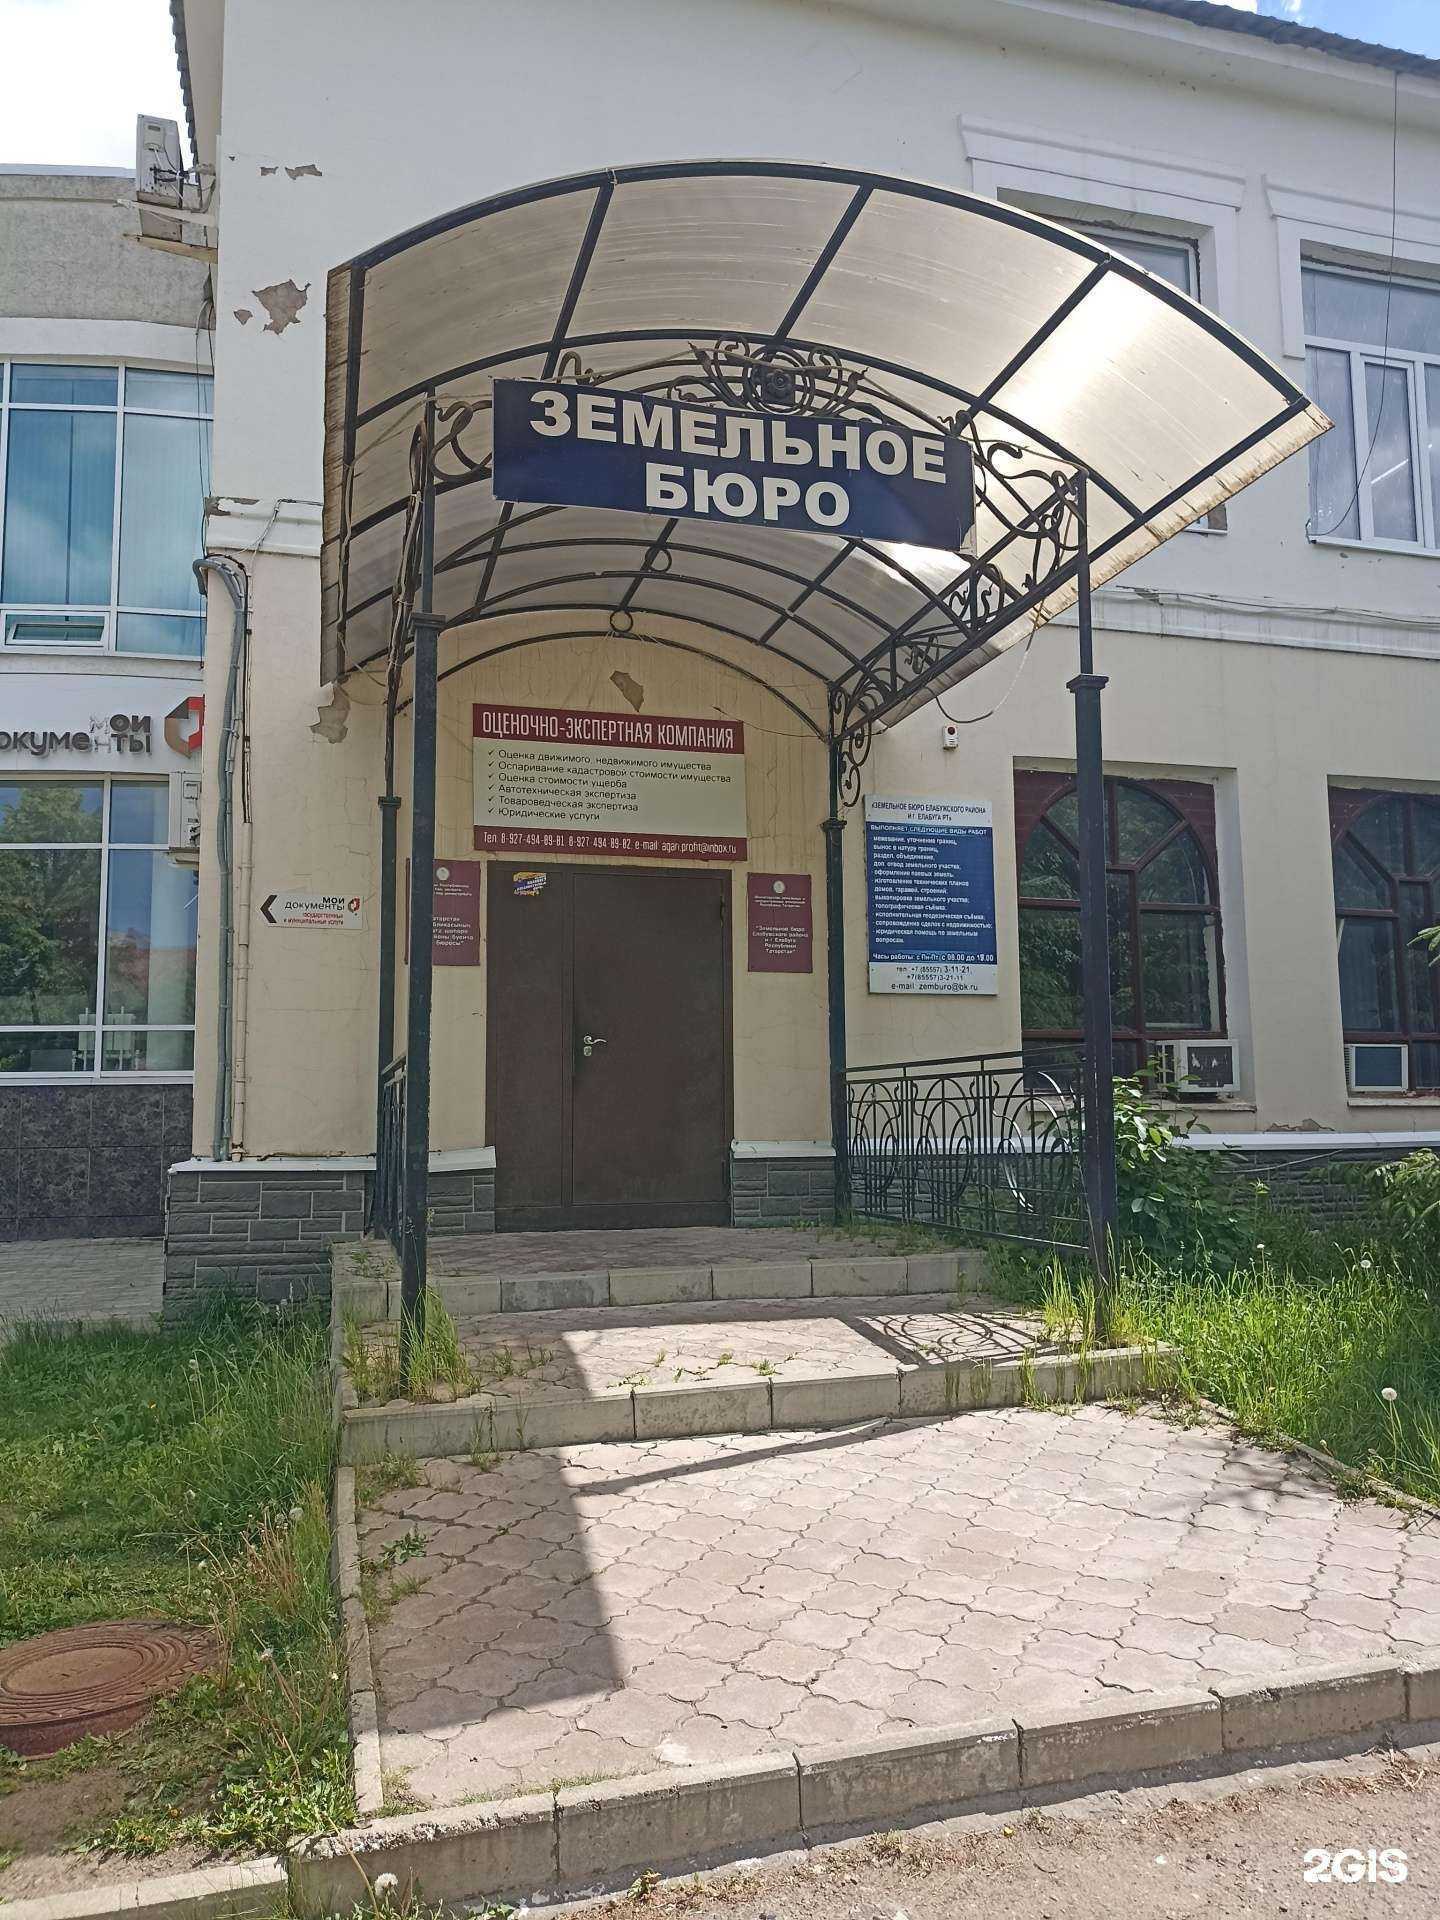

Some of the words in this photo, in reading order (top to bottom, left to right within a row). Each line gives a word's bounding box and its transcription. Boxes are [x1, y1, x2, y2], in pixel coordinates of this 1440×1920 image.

[530, 389, 948, 484] ЗЕМЕЛЬНОЕ
[645, 462, 850, 527] БЮРО
[482, 711, 652, 744] ОЦЕНОЧНО-ЭКСПЕРТНАЯ
[658, 724, 734, 749] КОМПАНИЯ
[498, 749, 535, 761] Оценка
[596, 757, 658, 768] недвижимого
[660, 761, 712, 772] имущества
[498, 761, 564, 773] Оспаривание
[567, 766, 627, 777] кадастровой
[629, 769, 678, 780] стоимости
[681, 773, 731, 783] имущества
[498, 772, 535, 784] Оценка
[538, 775, 589, 786] стоимости
[591, 779, 627, 789] ущерба
[498, 784, 582, 797] Автотехническая
[585, 789, 637, 801] экспертиза
[498, 795, 583, 808] Товароведческая
[586, 801, 639, 812] экспертиза
[498, 807, 566, 819] Юридические
[569, 812, 600, 822] услуги
[285, 901, 345, 911] документы
[918, 982, 978, 992] zemburo@bk.ru
